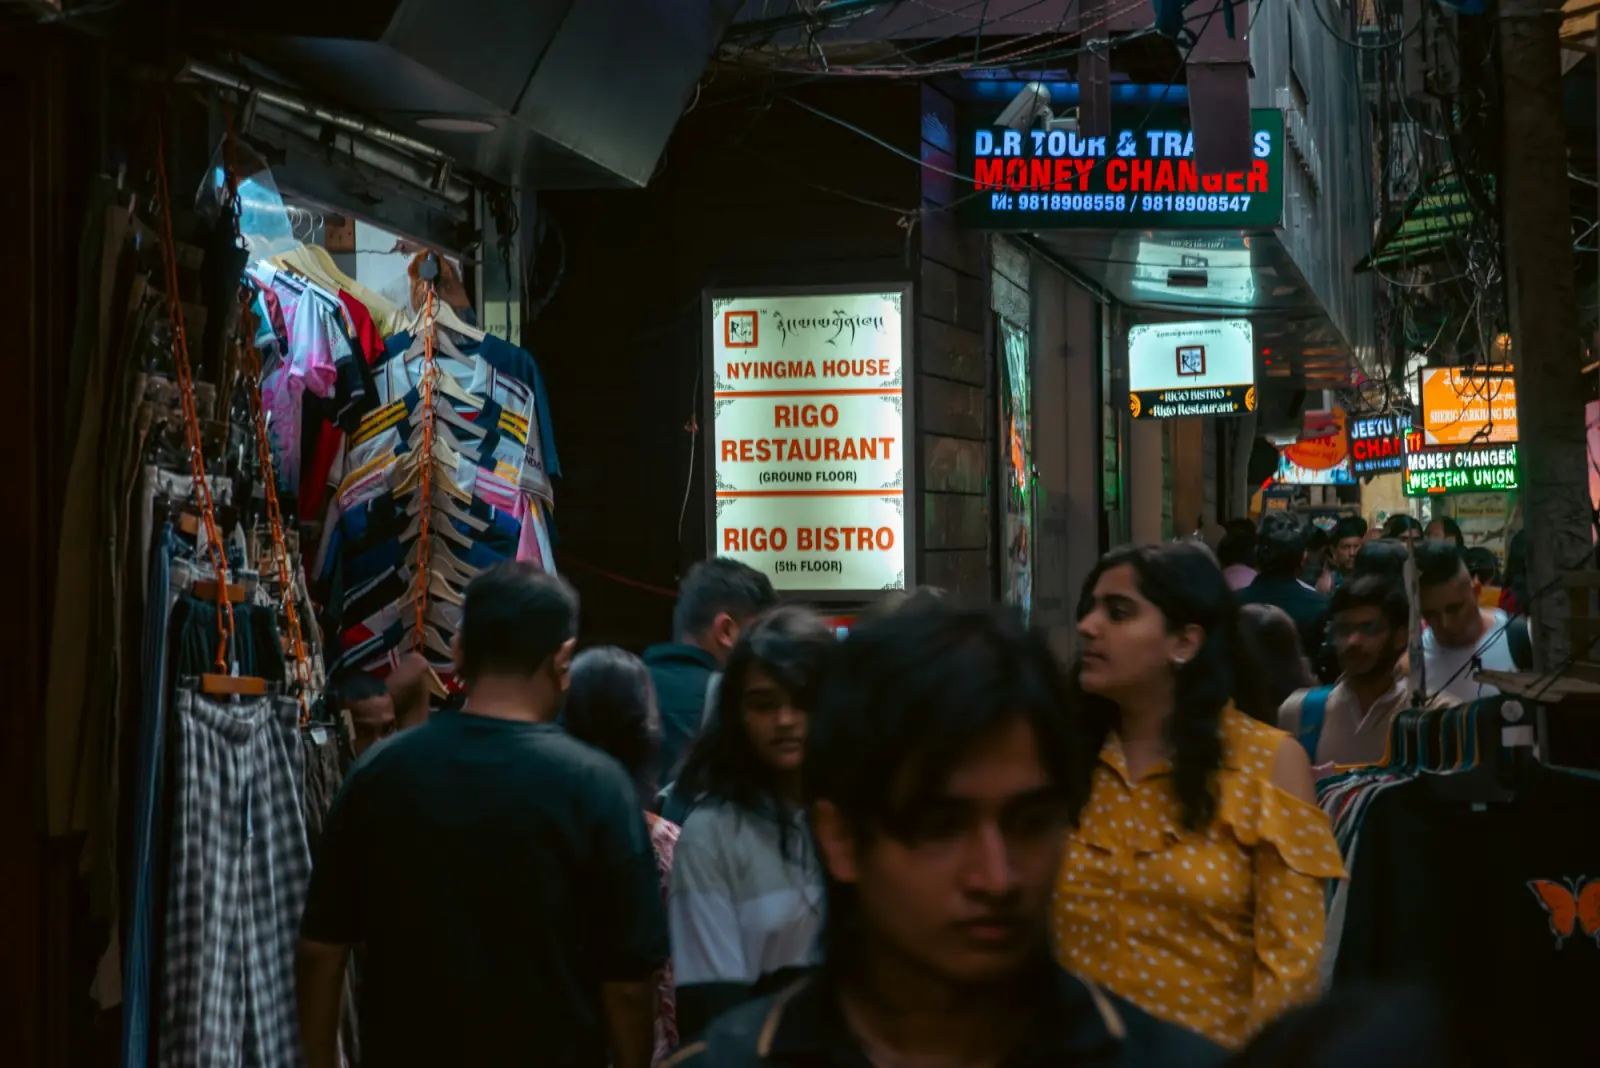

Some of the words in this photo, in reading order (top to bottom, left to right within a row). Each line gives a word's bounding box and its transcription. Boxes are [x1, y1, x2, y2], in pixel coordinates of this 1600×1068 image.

[974, 130, 1022, 157] D.R
[1030, 130, 1106, 157] TOUR
[1116, 130, 1137, 157] &
[1146, 130, 1271, 157] TRAS
[974, 158, 1097, 193] MONEY
[1105, 158, 1269, 193] CHANGER
[991, 195, 1013, 211] M:
[1018, 194, 1126, 212] 9818908558
[1129, 195, 1138, 213] /
[1142, 194, 1251, 212] 9818908547
[727, 360, 816, 380] NYINGMA
[823, 359, 890, 377] HOUSE
[1164, 390, 1189, 402] RIGO
[1190, 388, 1225, 401] BISTRO
[774, 404, 839, 428] RIGO
[1153, 404, 1176, 418] Rigo
[1177, 401, 1234, 416] Restaurant
[1351, 418, 1393, 439] JEETU
[721, 437, 895, 462] RESTAURANT
[1407, 453, 1451, 471] MONEY
[1455, 450, 1514, 467] CHANGER
[759, 471, 812, 484] (GROUND
[815, 470, 857, 484] FLOOR)
[1410, 472, 1469, 489] WESTERN
[1473, 468, 1515, 486] UNION
[723, 527, 787, 552] RIGO
[796, 526, 895, 551] BISTRO
[775, 560, 797, 574] (5th
[800, 560, 843, 574] FLOOR)
